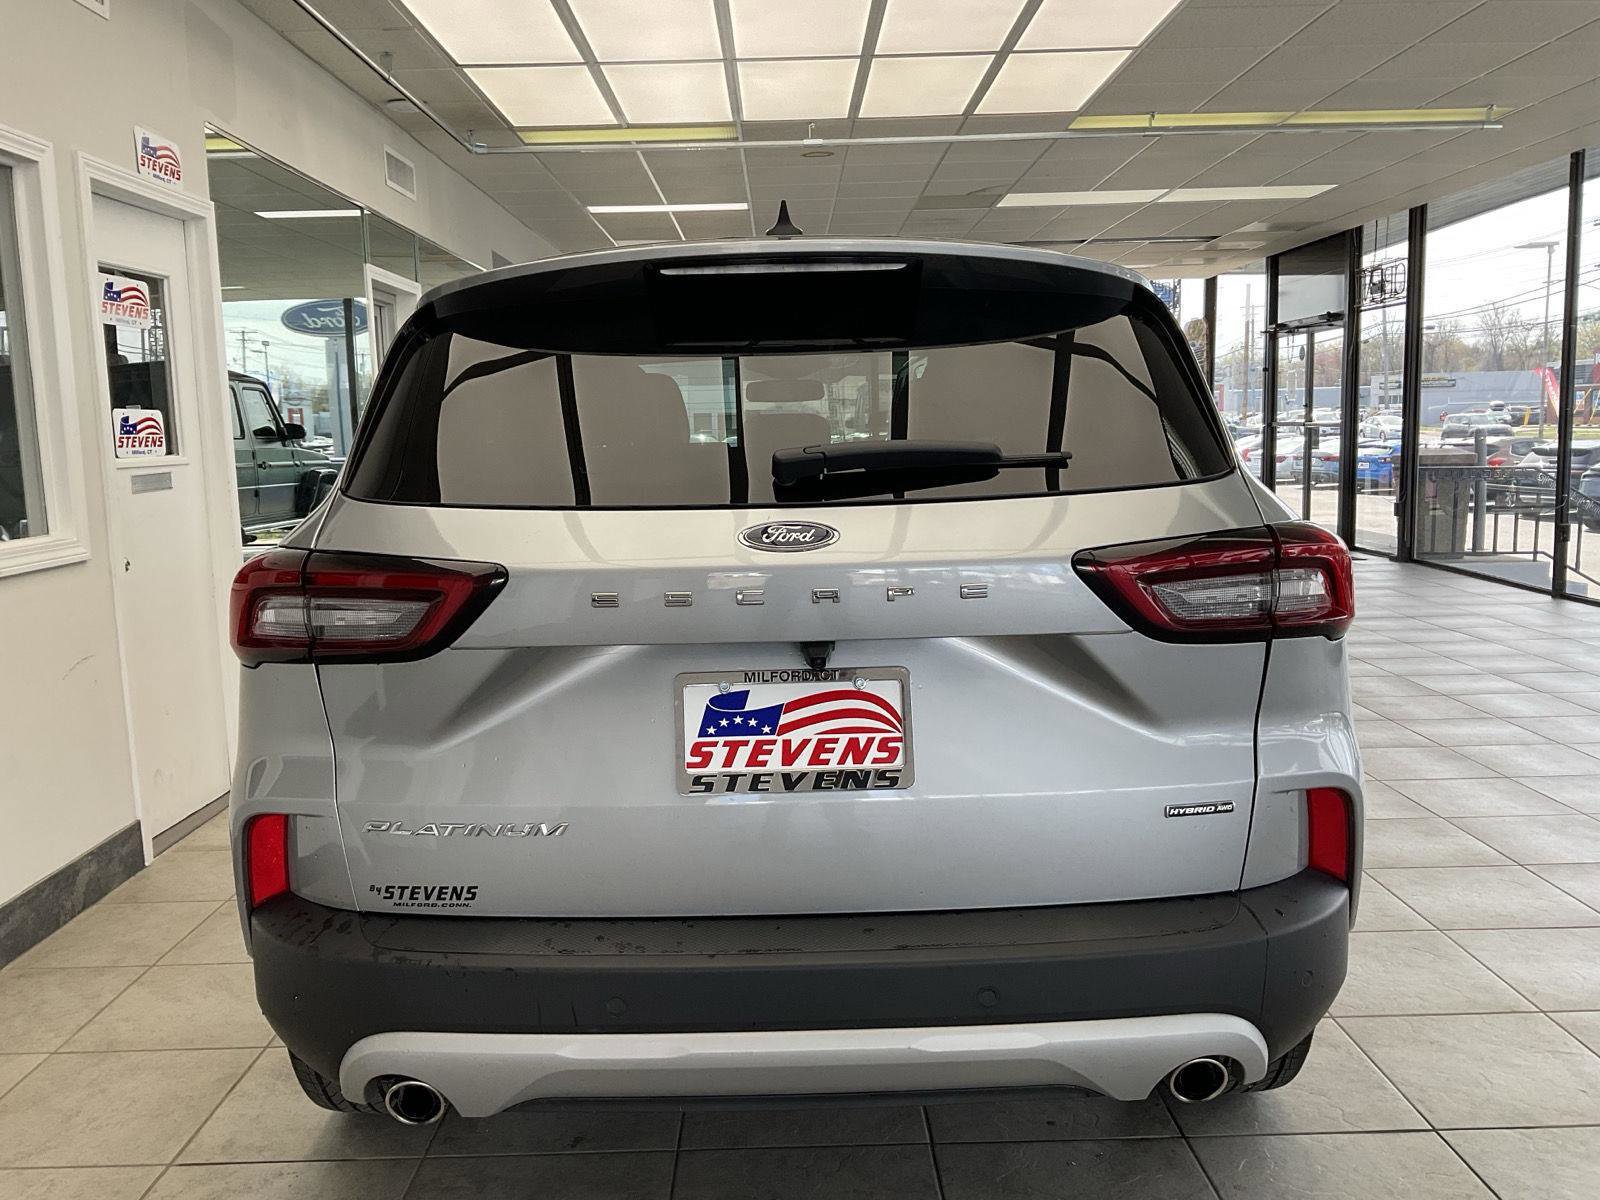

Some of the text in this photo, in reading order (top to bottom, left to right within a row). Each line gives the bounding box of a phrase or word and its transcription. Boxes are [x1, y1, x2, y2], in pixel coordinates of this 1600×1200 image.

[140, 155, 181, 181] STEVENS
[102, 302, 148, 319] STEVENS
[118, 436, 163, 448] STEVENS
[762, 525, 816, 543] Ford
[591, 583, 989, 608] ESCAPE
[686, 736, 903, 769] STEVENS
[689, 769, 902, 793] STEVENS
[1169, 805, 1215, 815] HYBRID
[362, 821, 569, 837] PLATINUM
[383, 885, 479, 901] STEVENS
